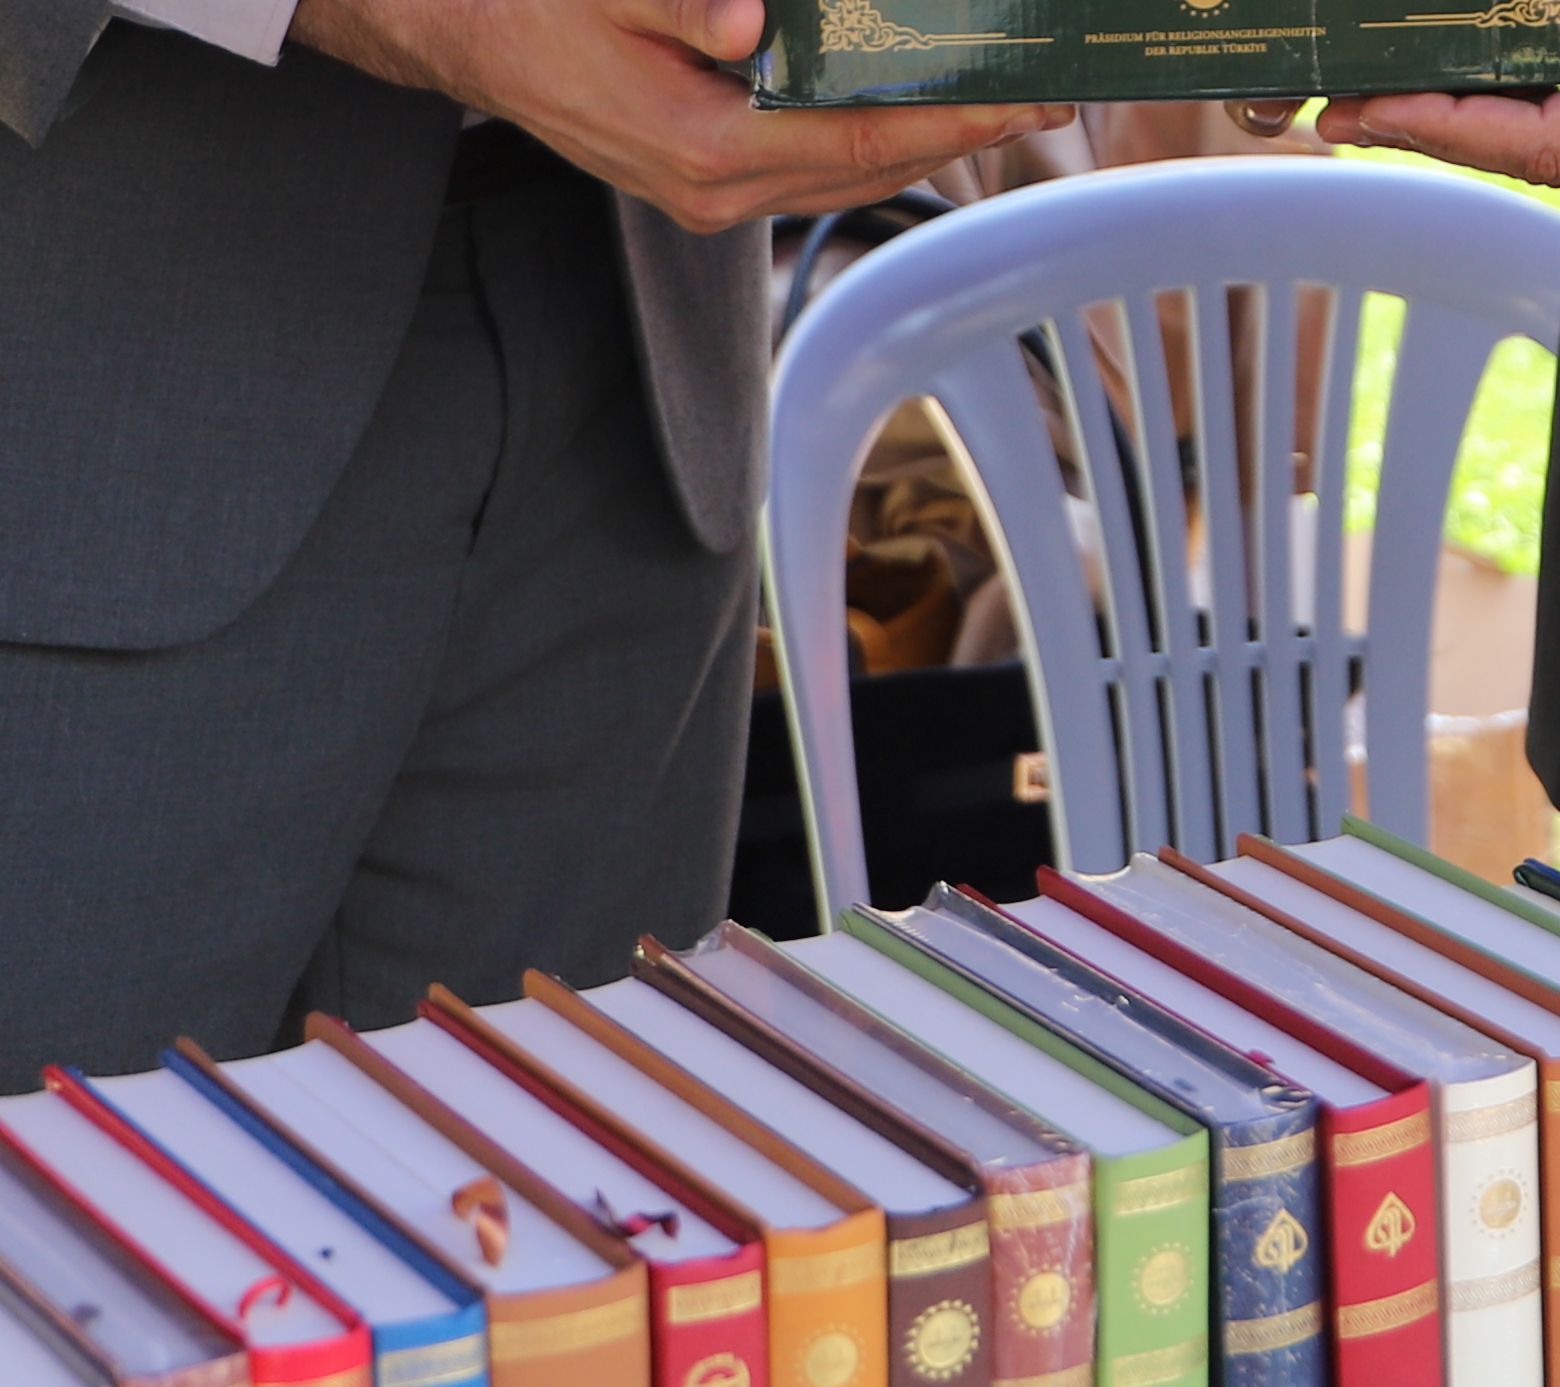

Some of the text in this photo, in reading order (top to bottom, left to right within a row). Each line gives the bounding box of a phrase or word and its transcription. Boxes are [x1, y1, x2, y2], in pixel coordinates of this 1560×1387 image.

[1085, 32, 1144, 44] PRÄSIDIUM
[1145, 46, 1167, 56] DER
[1169, 44, 1220, 56] REPUBLIK
